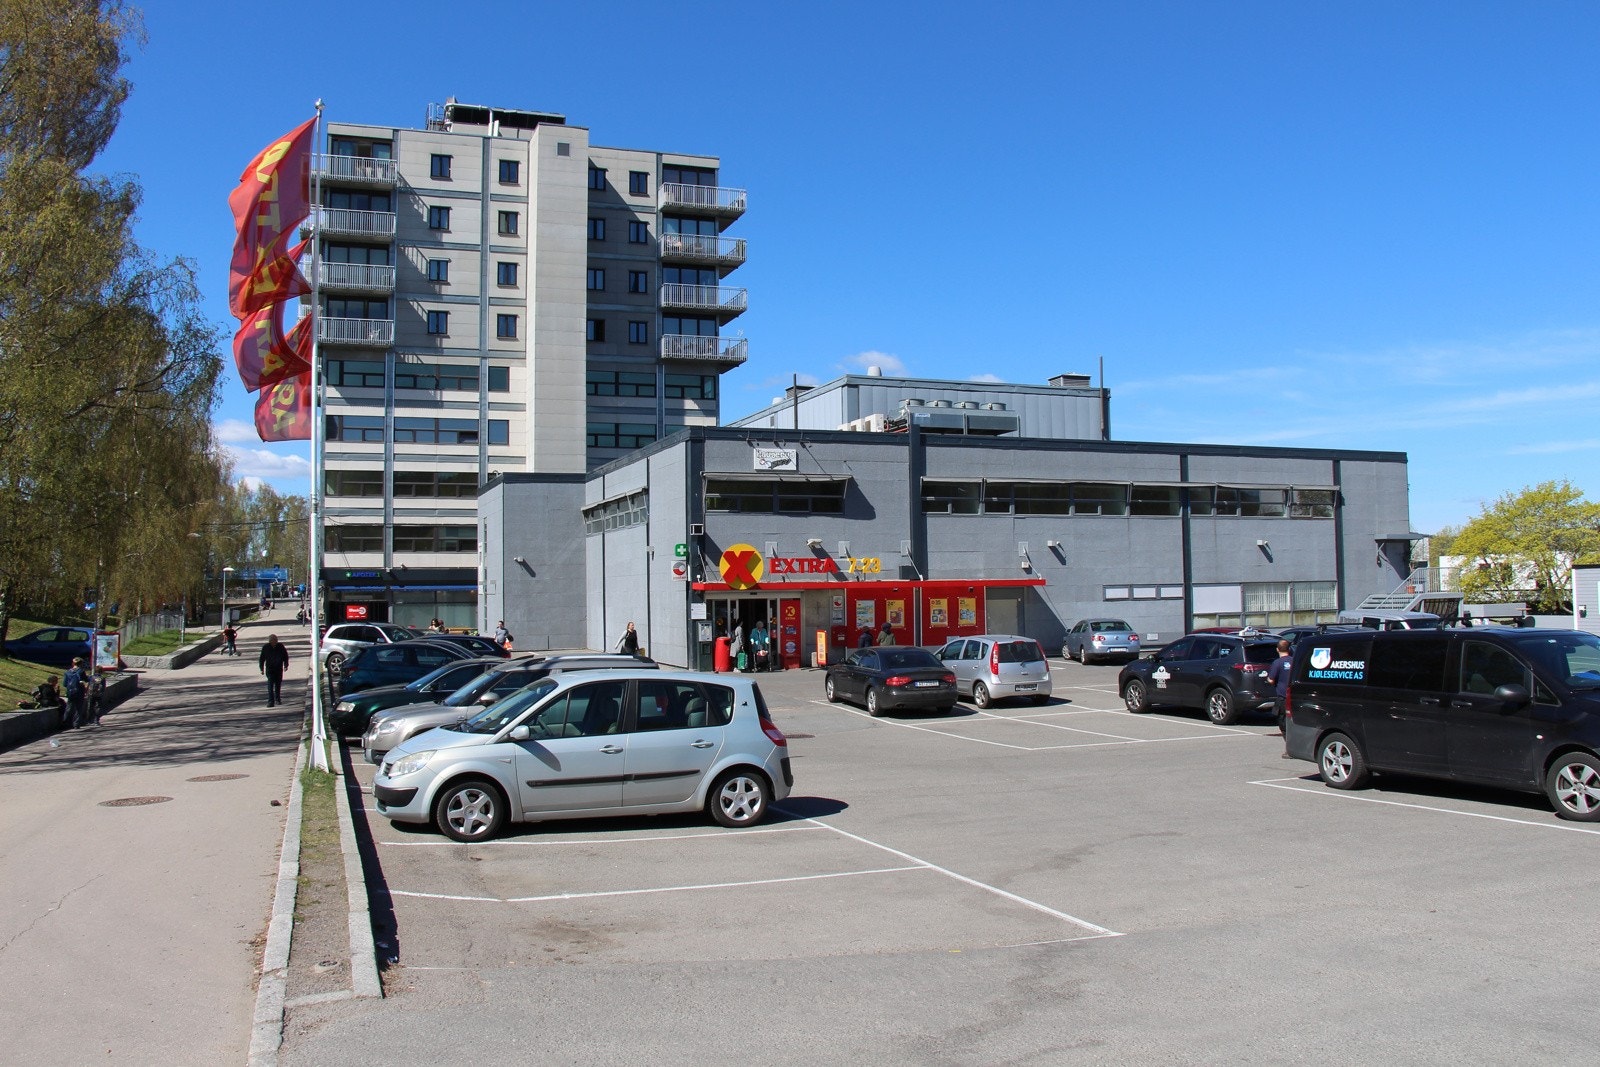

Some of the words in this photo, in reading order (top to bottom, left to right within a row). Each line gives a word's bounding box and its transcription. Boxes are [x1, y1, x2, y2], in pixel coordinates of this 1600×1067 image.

[769, 557, 839, 574] EXTRA
[848, 557, 881, 574] 7-23
[1330, 660, 1365, 670] AKERSHUS
[1308, 669, 1353, 679] KJØLESERVICE
[1353, 671, 1364, 680] AS
